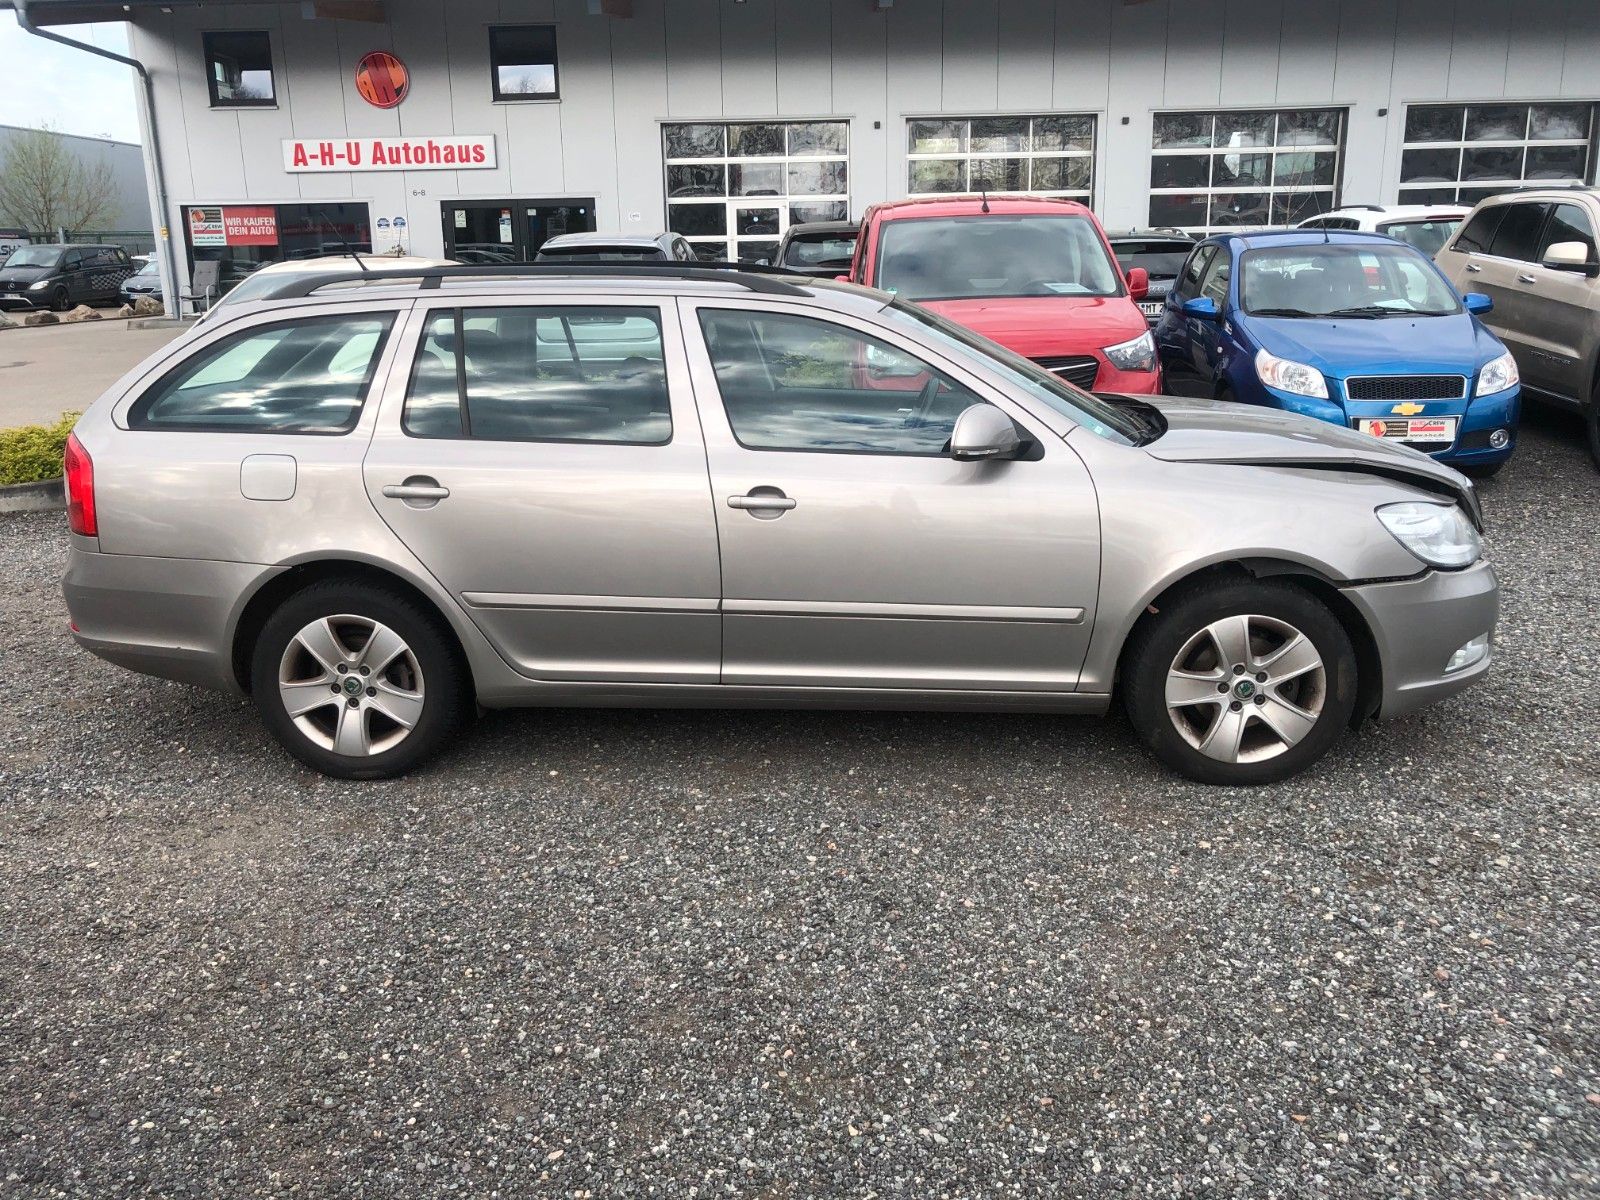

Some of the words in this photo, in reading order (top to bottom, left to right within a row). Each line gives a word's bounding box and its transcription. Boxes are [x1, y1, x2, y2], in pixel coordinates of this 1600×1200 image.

[293, 142, 361, 166] A-H-U
[372, 140, 485, 165] Autohaus
[225, 217, 242, 226] WIR
[244, 217, 276, 226] KAUFEN
[228, 226, 248, 235] DEIN
[249, 226, 275, 235] AUTO!
[1145, 303, 1157, 313] MT
